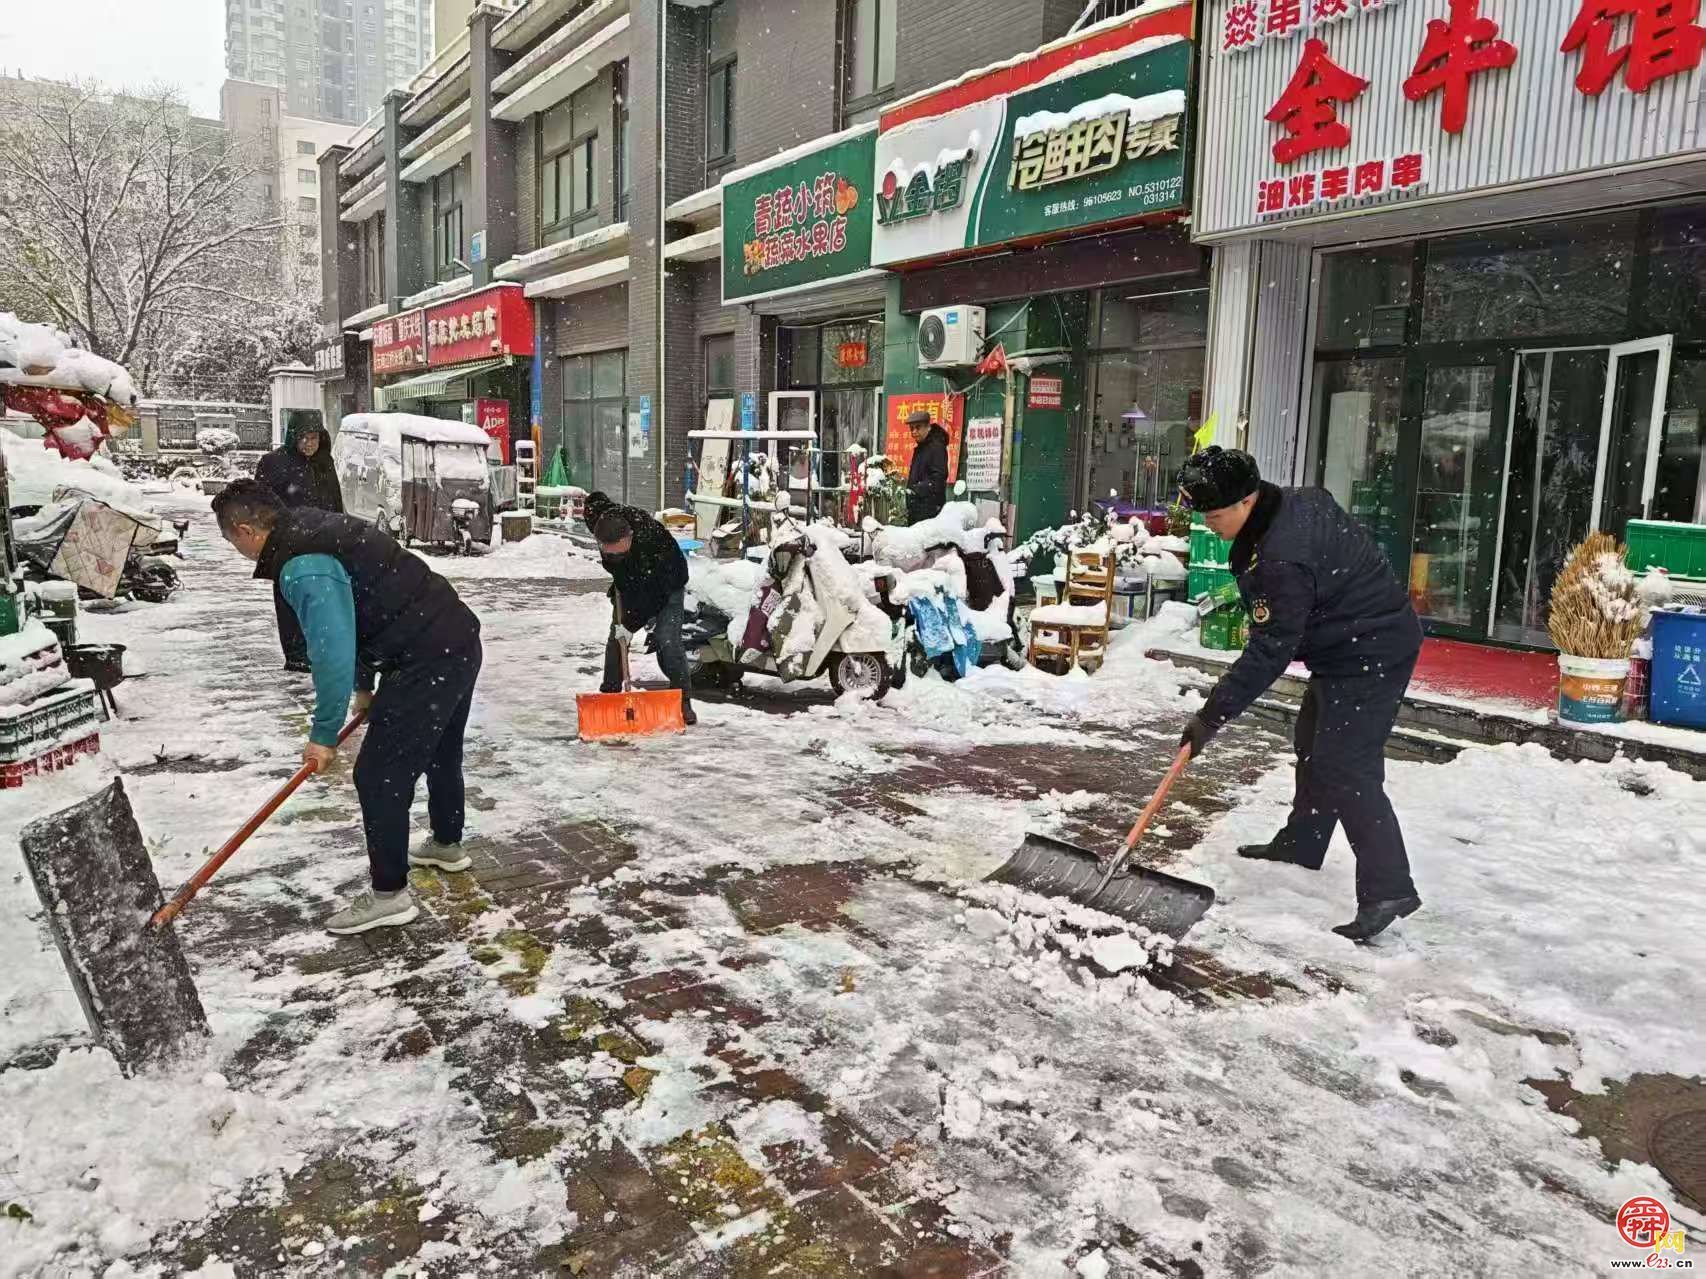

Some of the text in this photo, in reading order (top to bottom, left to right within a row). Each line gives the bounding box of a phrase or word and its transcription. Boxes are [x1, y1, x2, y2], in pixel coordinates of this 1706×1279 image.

[1264, 0, 1706, 164] 全牛馆
[1257, 152, 1425, 214] 油炸羊肉串
[763, 216, 847, 269] 蔬菜水果店
